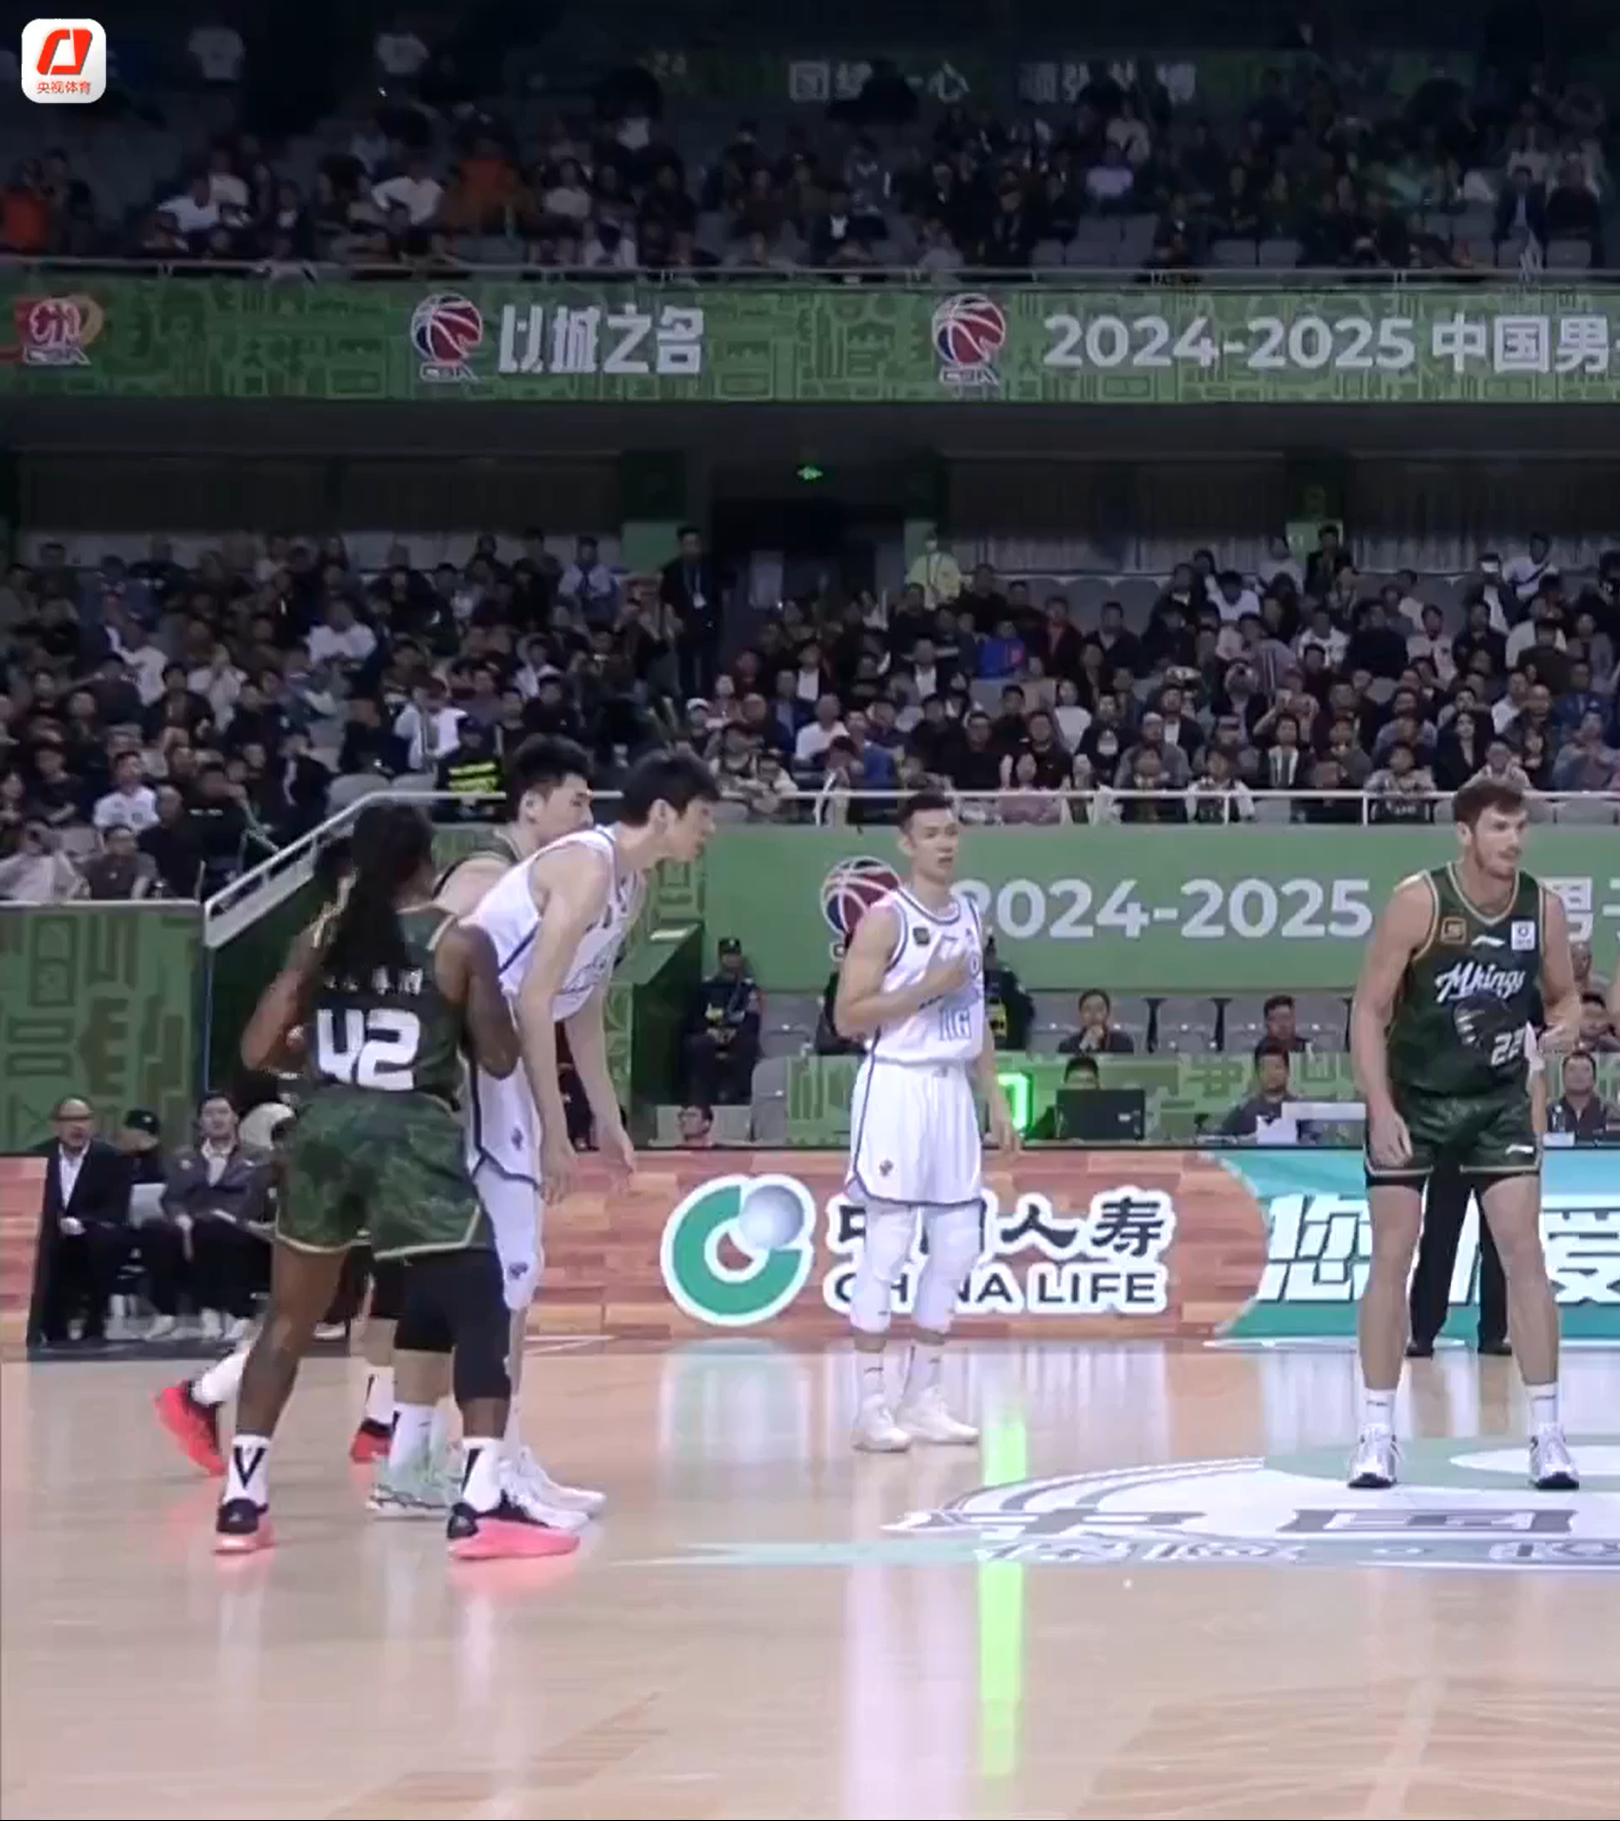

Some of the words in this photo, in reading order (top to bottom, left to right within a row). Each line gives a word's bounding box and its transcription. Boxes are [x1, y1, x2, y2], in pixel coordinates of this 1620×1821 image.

[499, 303, 704, 374] 以城之名
[1043, 313, 1415, 368] 2024-2025
[317, 1007, 421, 1092] 42
[838, 1196, 1164, 1258] 人寿
[1037, 1272, 1157, 1303] LIFE
